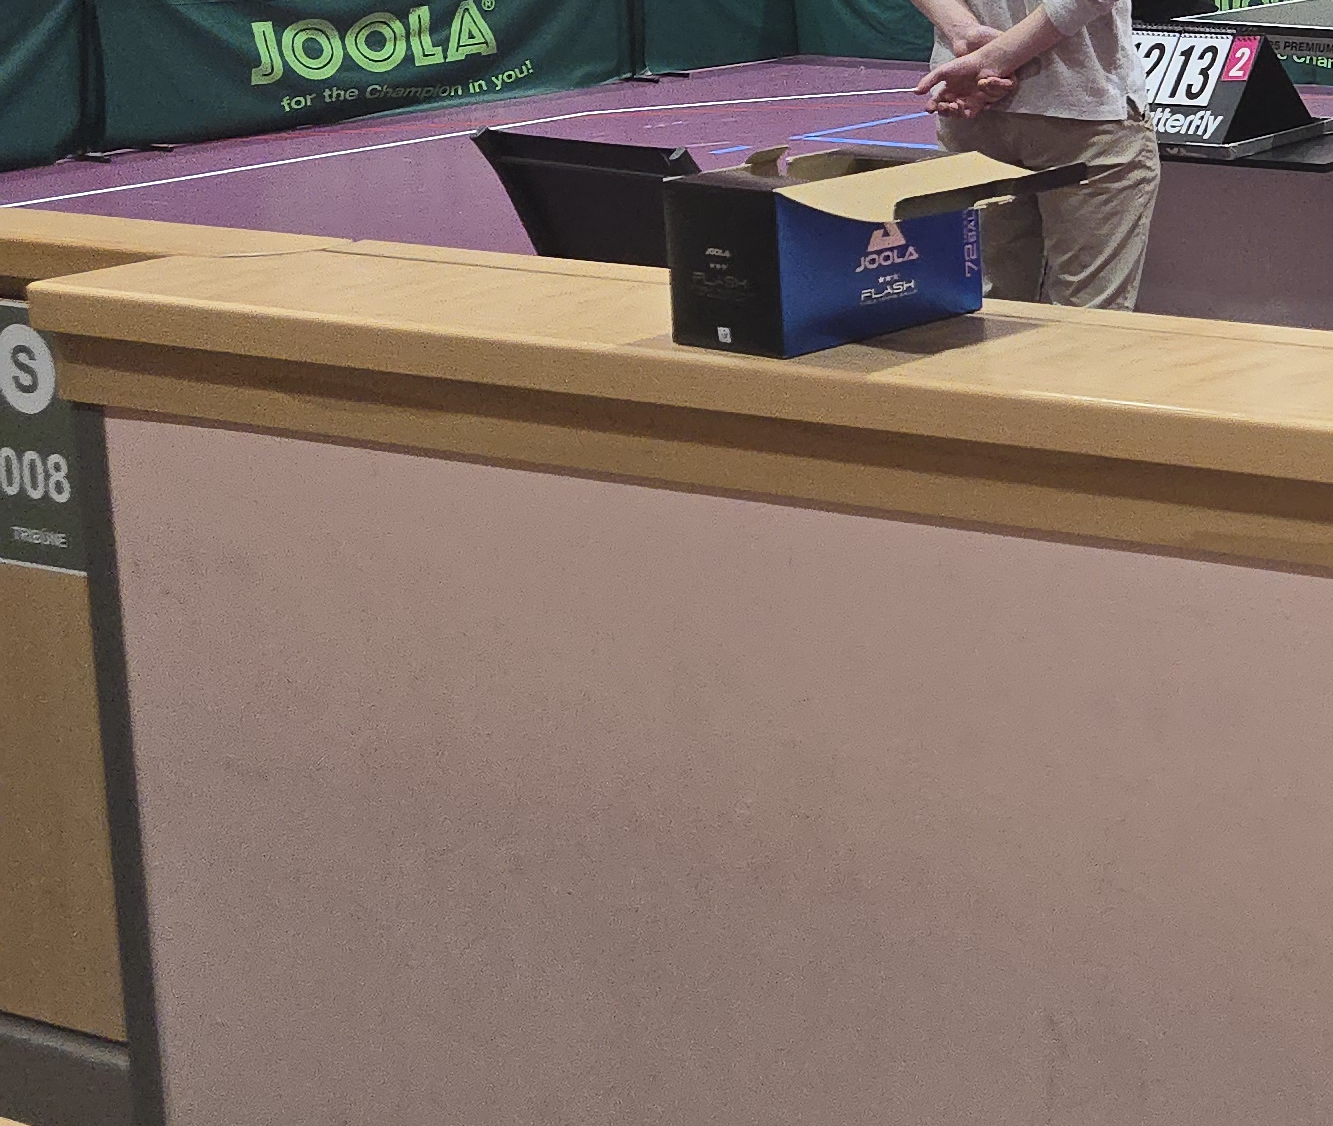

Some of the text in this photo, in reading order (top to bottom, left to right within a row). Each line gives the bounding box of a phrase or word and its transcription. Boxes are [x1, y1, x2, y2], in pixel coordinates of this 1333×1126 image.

[250, 0, 497, 85] JOOLA
[281, 59, 535, 112] for the Champion in you!
[1168, 45, 1219, 100] 13
[1228, 47, 1250, 77] 2
[1150, 107, 1224, 140] tterfly
[855, 245, 919, 273] JOOLA
[861, 279, 915, 301] FLASH
[11, 344, 39, 393] S
[0, 447, 71, 503] 008
